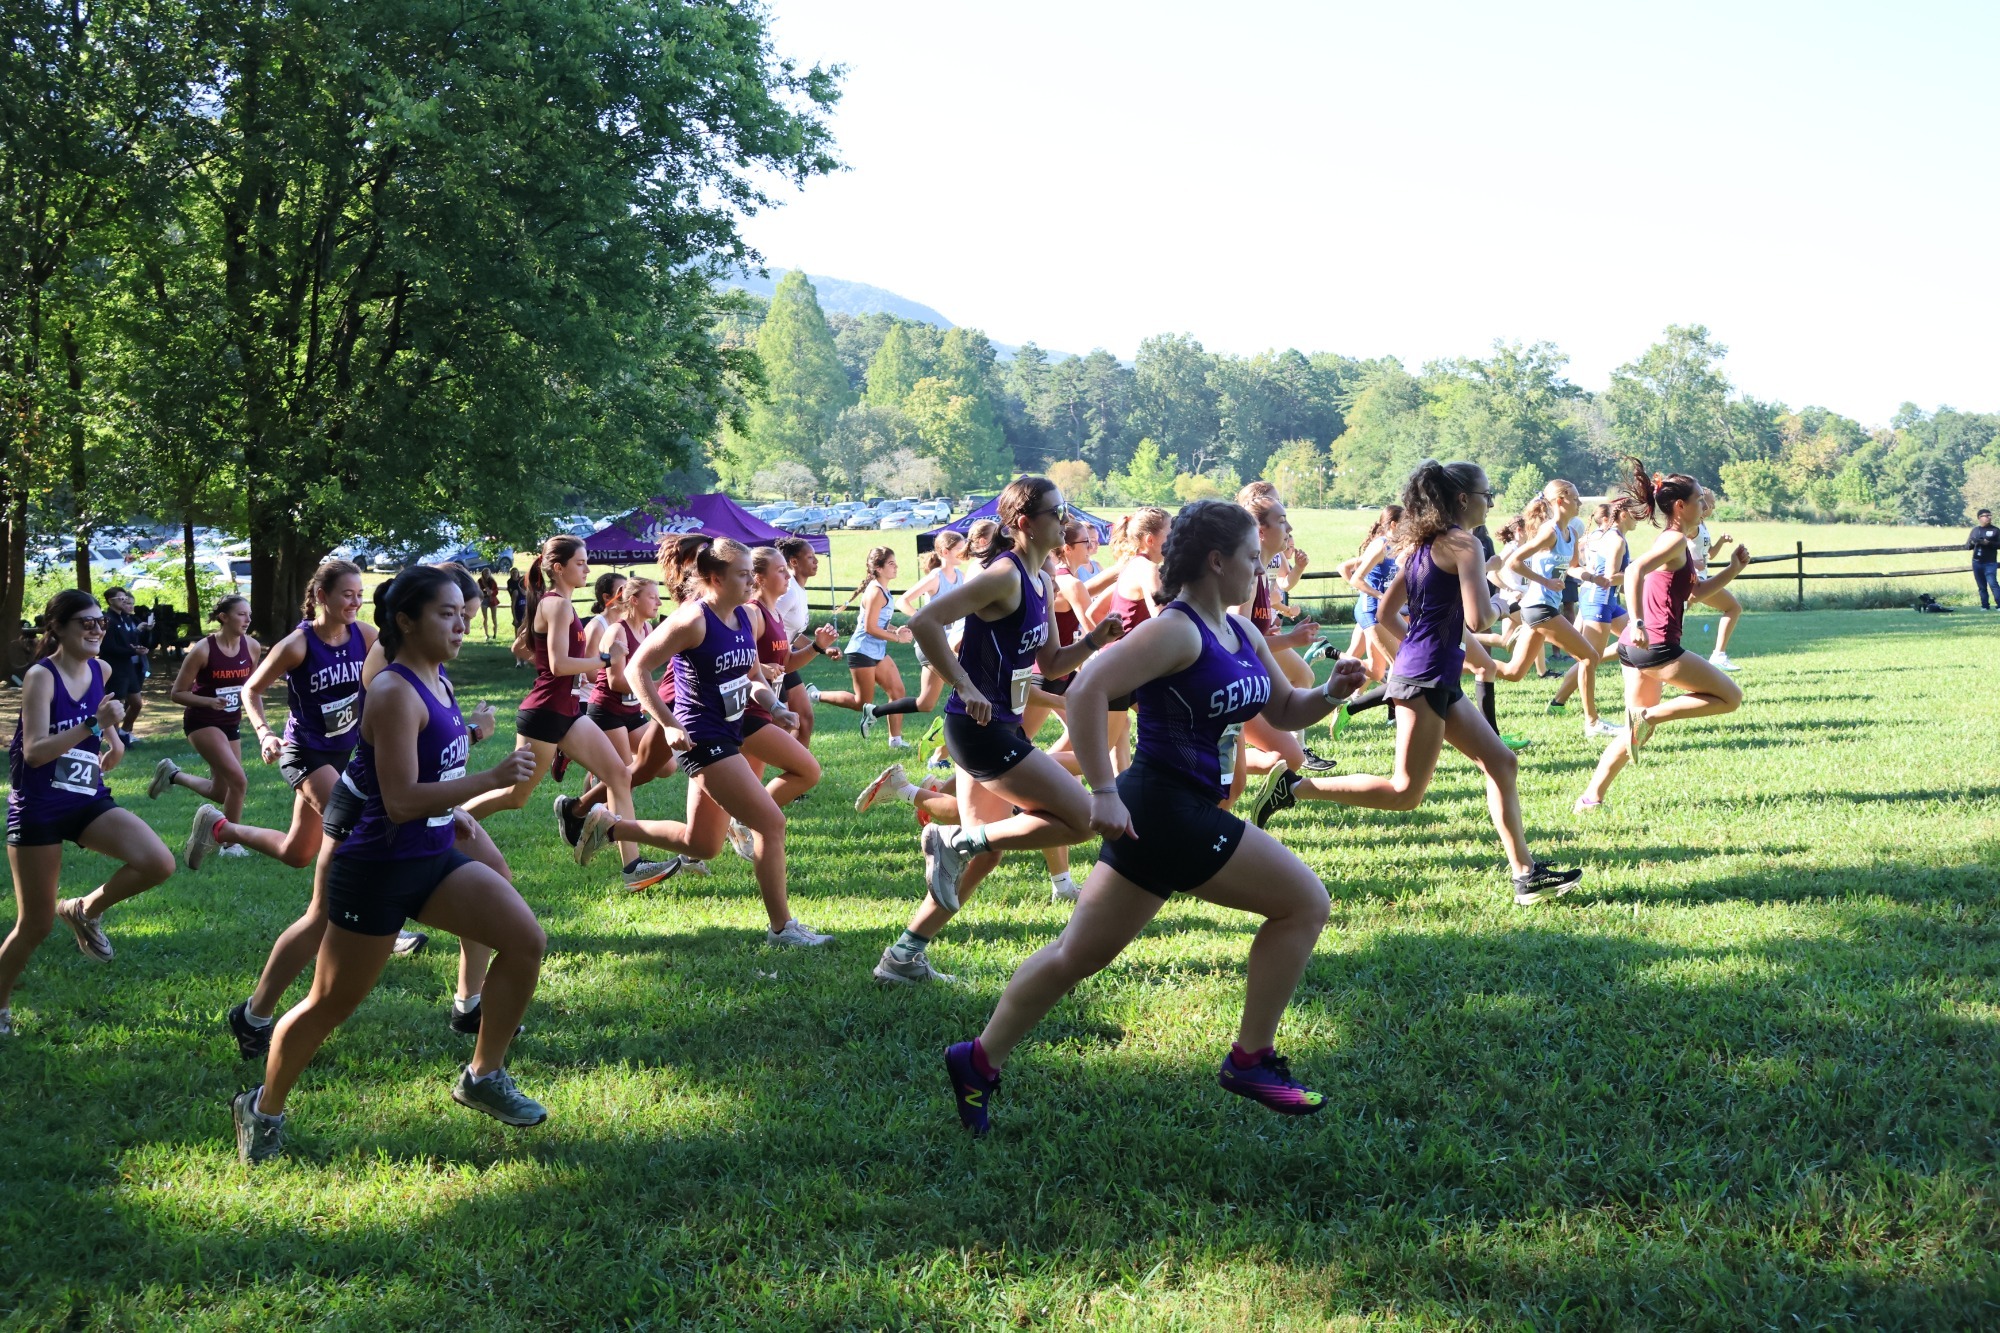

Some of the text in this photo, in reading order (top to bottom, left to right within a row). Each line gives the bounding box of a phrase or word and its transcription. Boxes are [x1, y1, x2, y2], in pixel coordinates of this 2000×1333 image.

[733, 687, 747, 710] 14
[1208, 676, 1271, 719] SEWAN
[336, 705, 353, 728] 26
[67, 762, 93, 785] 24
